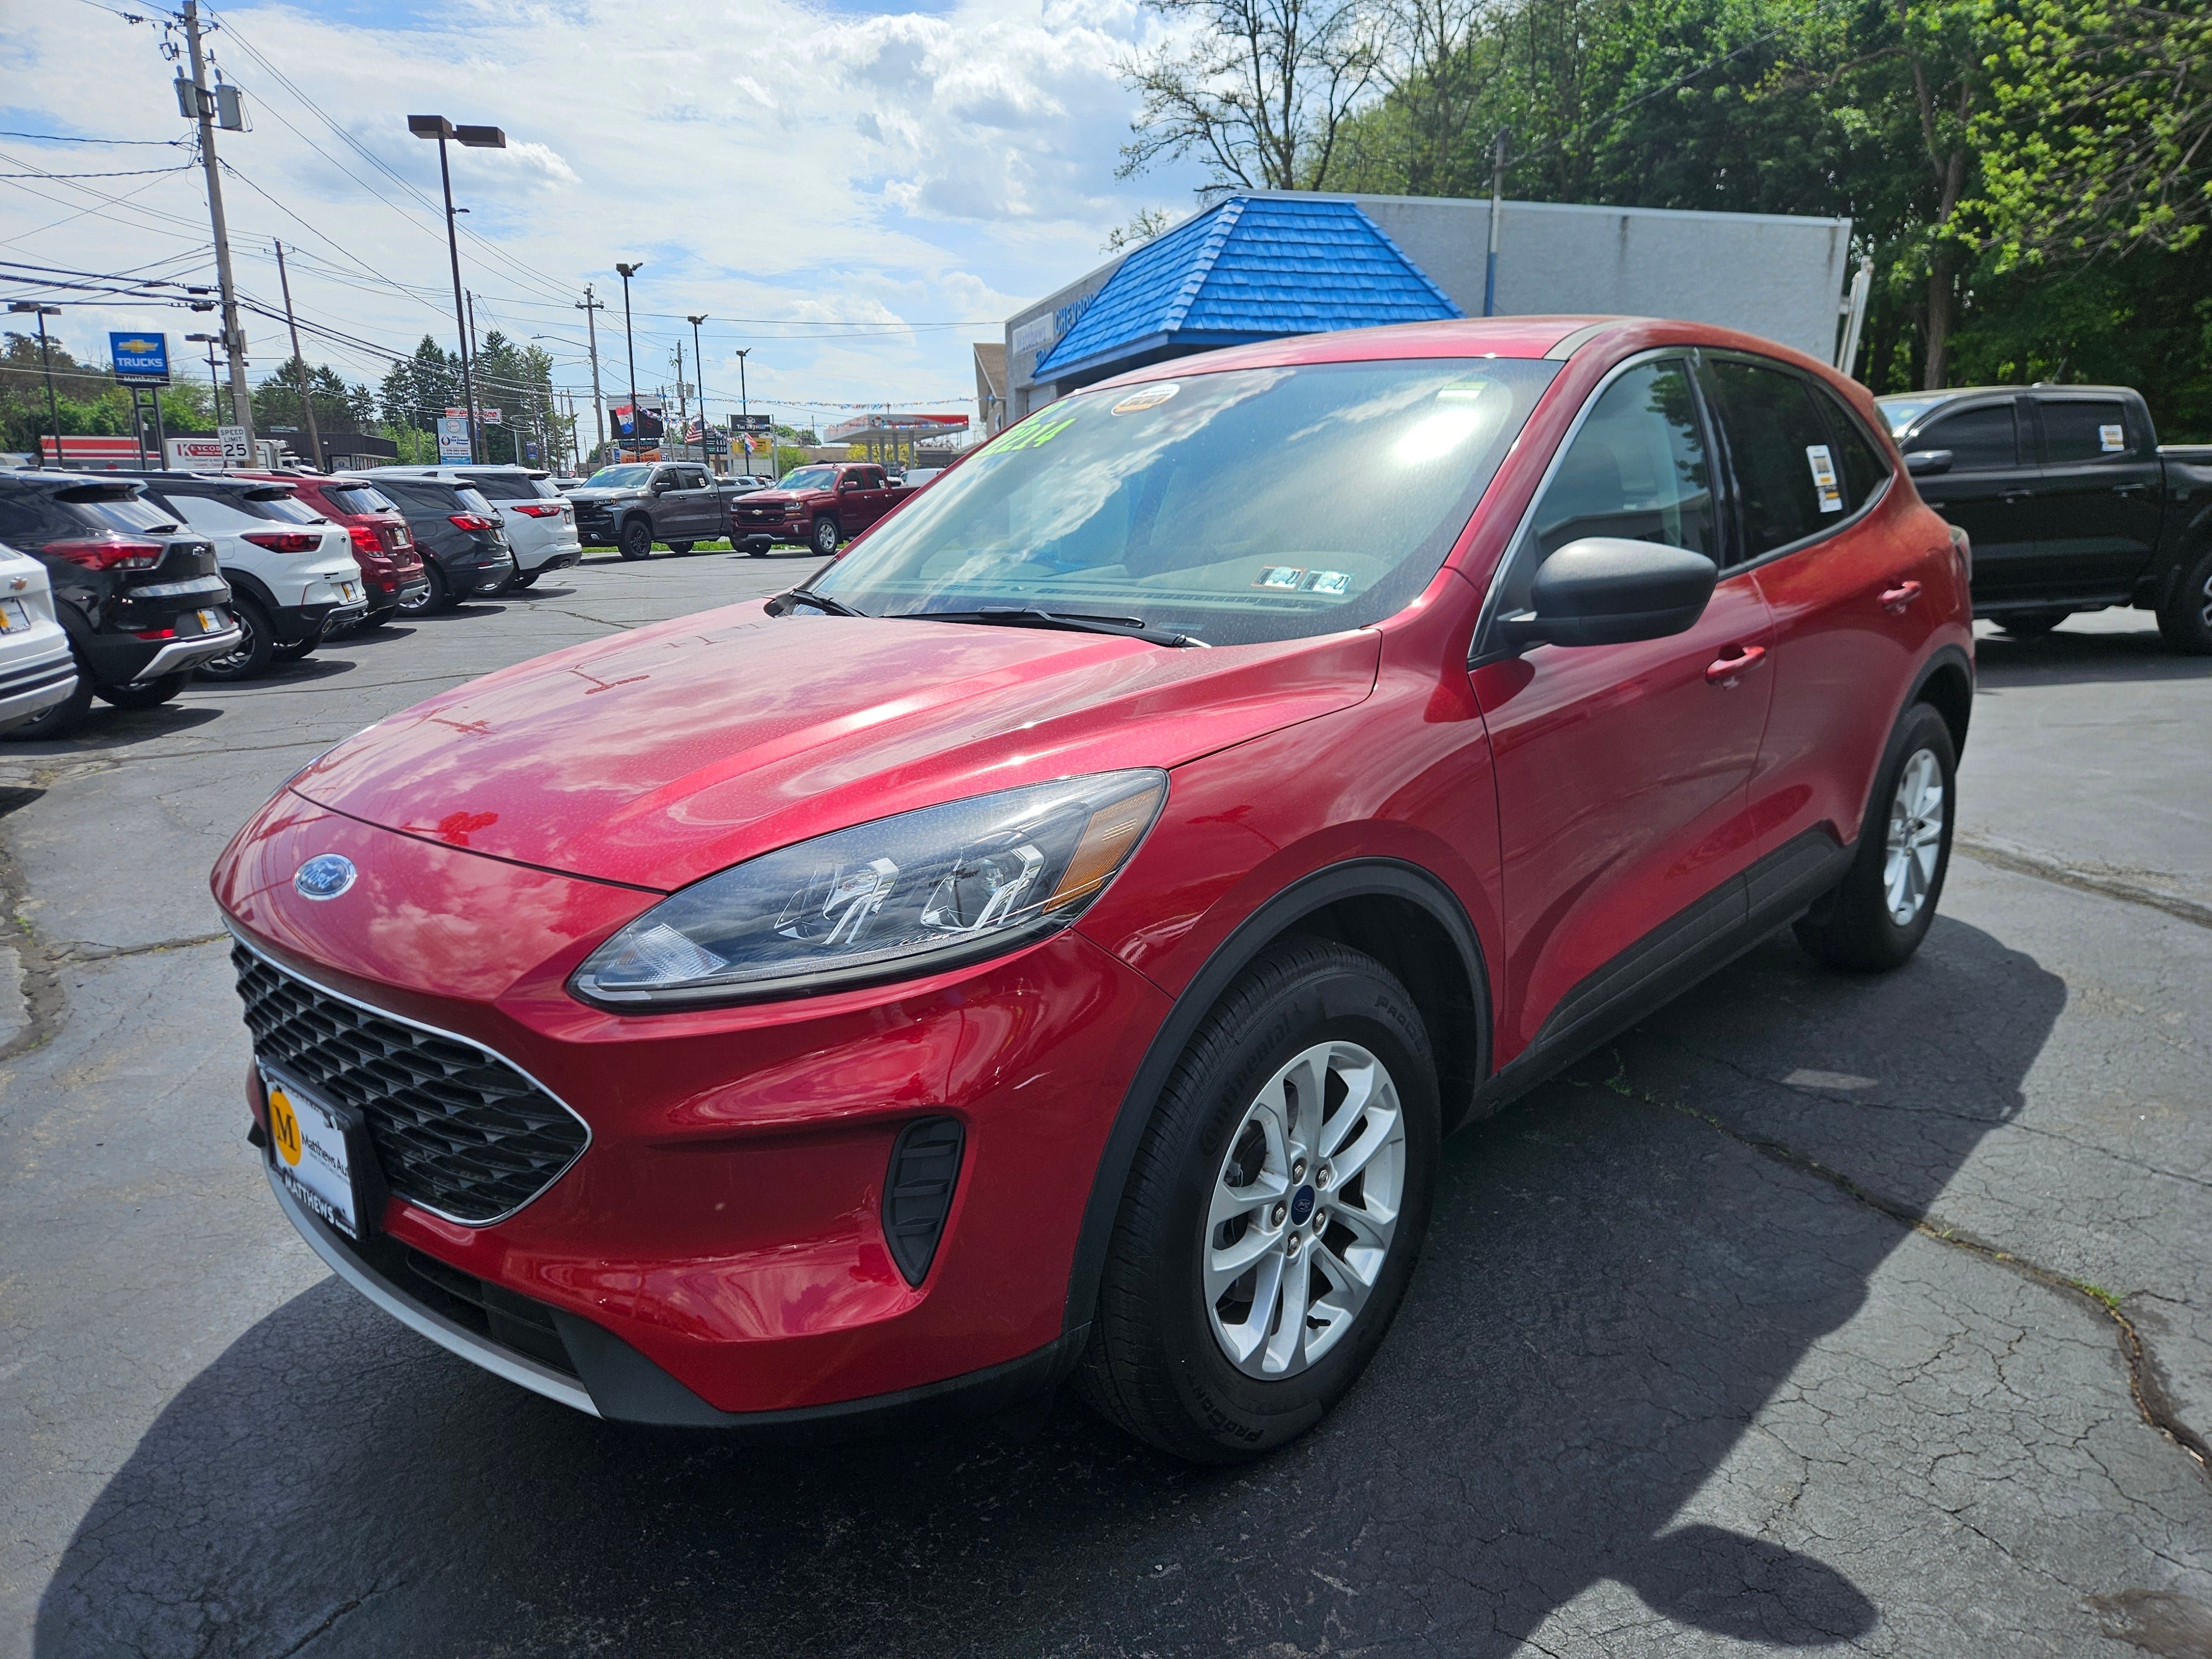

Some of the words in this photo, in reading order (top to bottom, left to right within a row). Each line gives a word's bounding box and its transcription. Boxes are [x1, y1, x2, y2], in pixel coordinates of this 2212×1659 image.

[116, 358, 163, 367] TRUCKS
[224, 444, 247, 457] 25
[273, 1104, 298, 1152] M
[301, 1131, 337, 1169] Matthews
[284, 1172, 335, 1224] MATTHEWS
